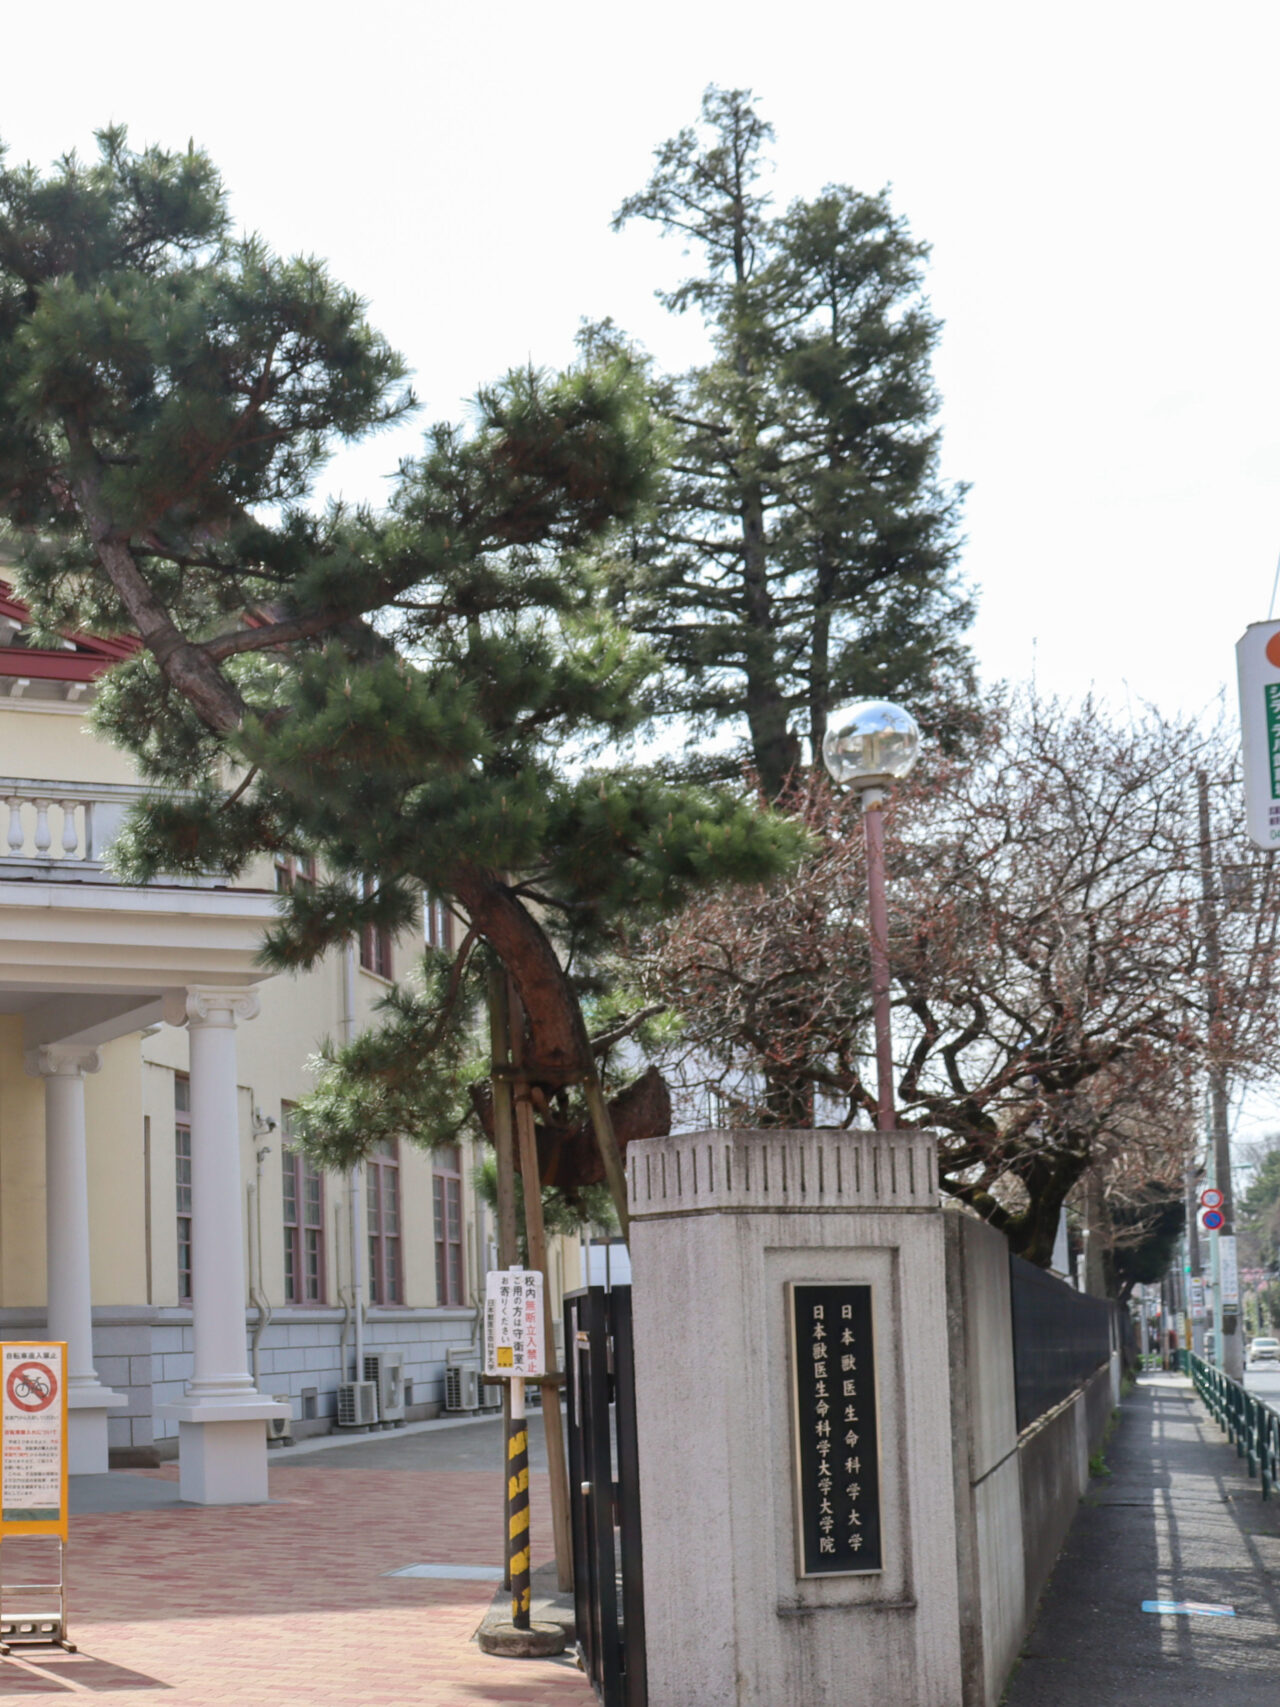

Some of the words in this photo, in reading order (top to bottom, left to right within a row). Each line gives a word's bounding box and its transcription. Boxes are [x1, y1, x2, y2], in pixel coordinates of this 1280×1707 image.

[500, 1277, 510, 1343] お寄りください
[513, 1277, 524, 1372] ご用の方は守衛室へ
[525, 1276, 537, 1373] 校内無断立入禁止
[812, 1304, 835, 1553] 日本獣医生命科学大学大学院
[841, 1304, 864, 1551] 日本獣医生命科学大学
